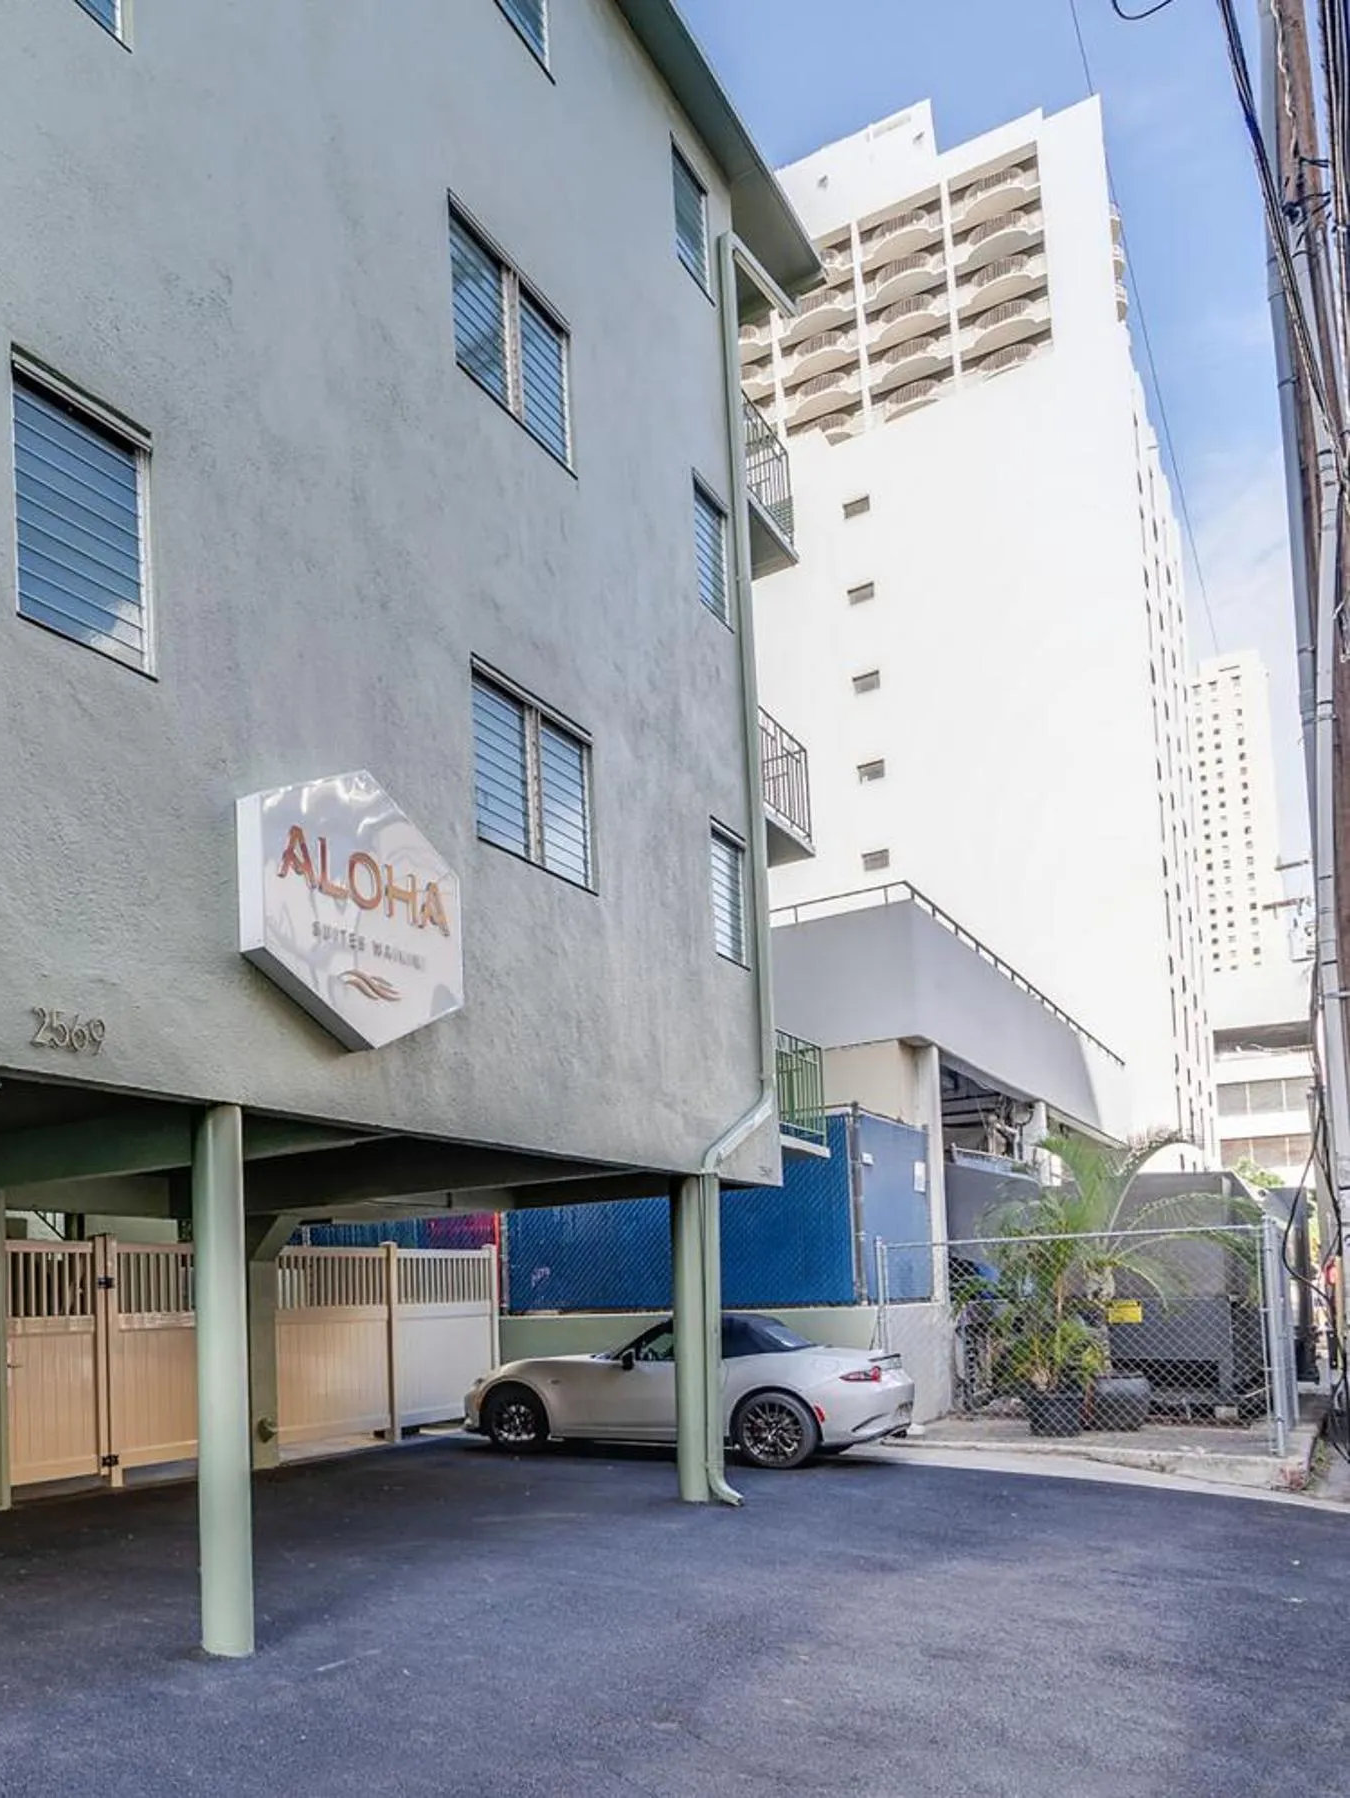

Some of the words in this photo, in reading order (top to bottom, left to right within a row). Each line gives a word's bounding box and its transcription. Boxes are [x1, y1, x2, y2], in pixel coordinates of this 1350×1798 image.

[278, 825, 450, 937] ALOHA
[312, 920, 366, 952] SUITES
[30, 1006, 106, 1056] 2569
